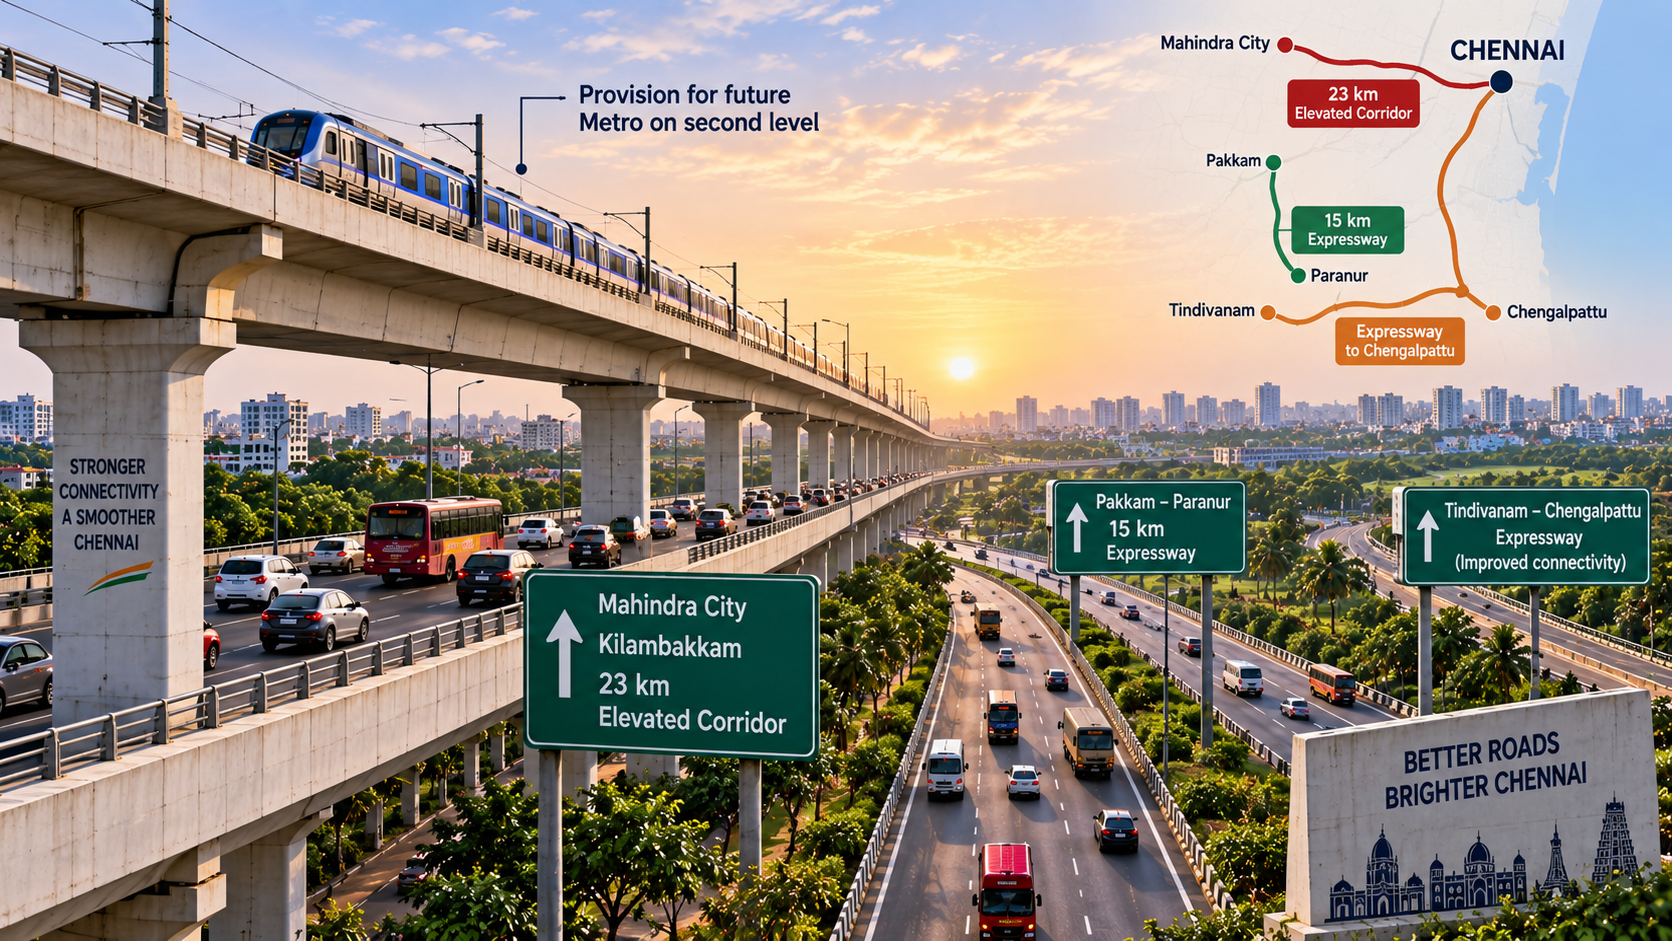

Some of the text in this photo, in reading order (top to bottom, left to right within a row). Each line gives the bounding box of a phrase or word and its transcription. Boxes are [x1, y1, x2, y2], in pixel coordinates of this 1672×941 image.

[69, 458, 146, 475] STRONGER
[59, 482, 160, 500] CONNECTIVITY
[1096, 492, 1156, 510] Pakkam
[1173, 493, 1232, 510] Paranur
[61, 508, 156, 526] A SMOOTHER
[1444, 501, 1528, 519] Tindivanam
[1544, 501, 1642, 523] Chengalpattu
[1109, 518, 1165, 538] 15 km
[73, 533, 139, 551] CHENNAI
[1496, 528, 1584, 550] Expressway
[1107, 544, 1197, 565] Expressway
[1455, 553, 1627, 574] (Improved connectivity)
[598, 592, 747, 623] Mahindra City
[599, 632, 742, 659] Kilambakkam
[599, 671, 670, 697] 23 km
[599, 705, 787, 735] Elevated Corridor
[1404, 731, 1559, 774] BETTER ROADS
[1385, 761, 1587, 810] BRIGHTER CHENNAI
